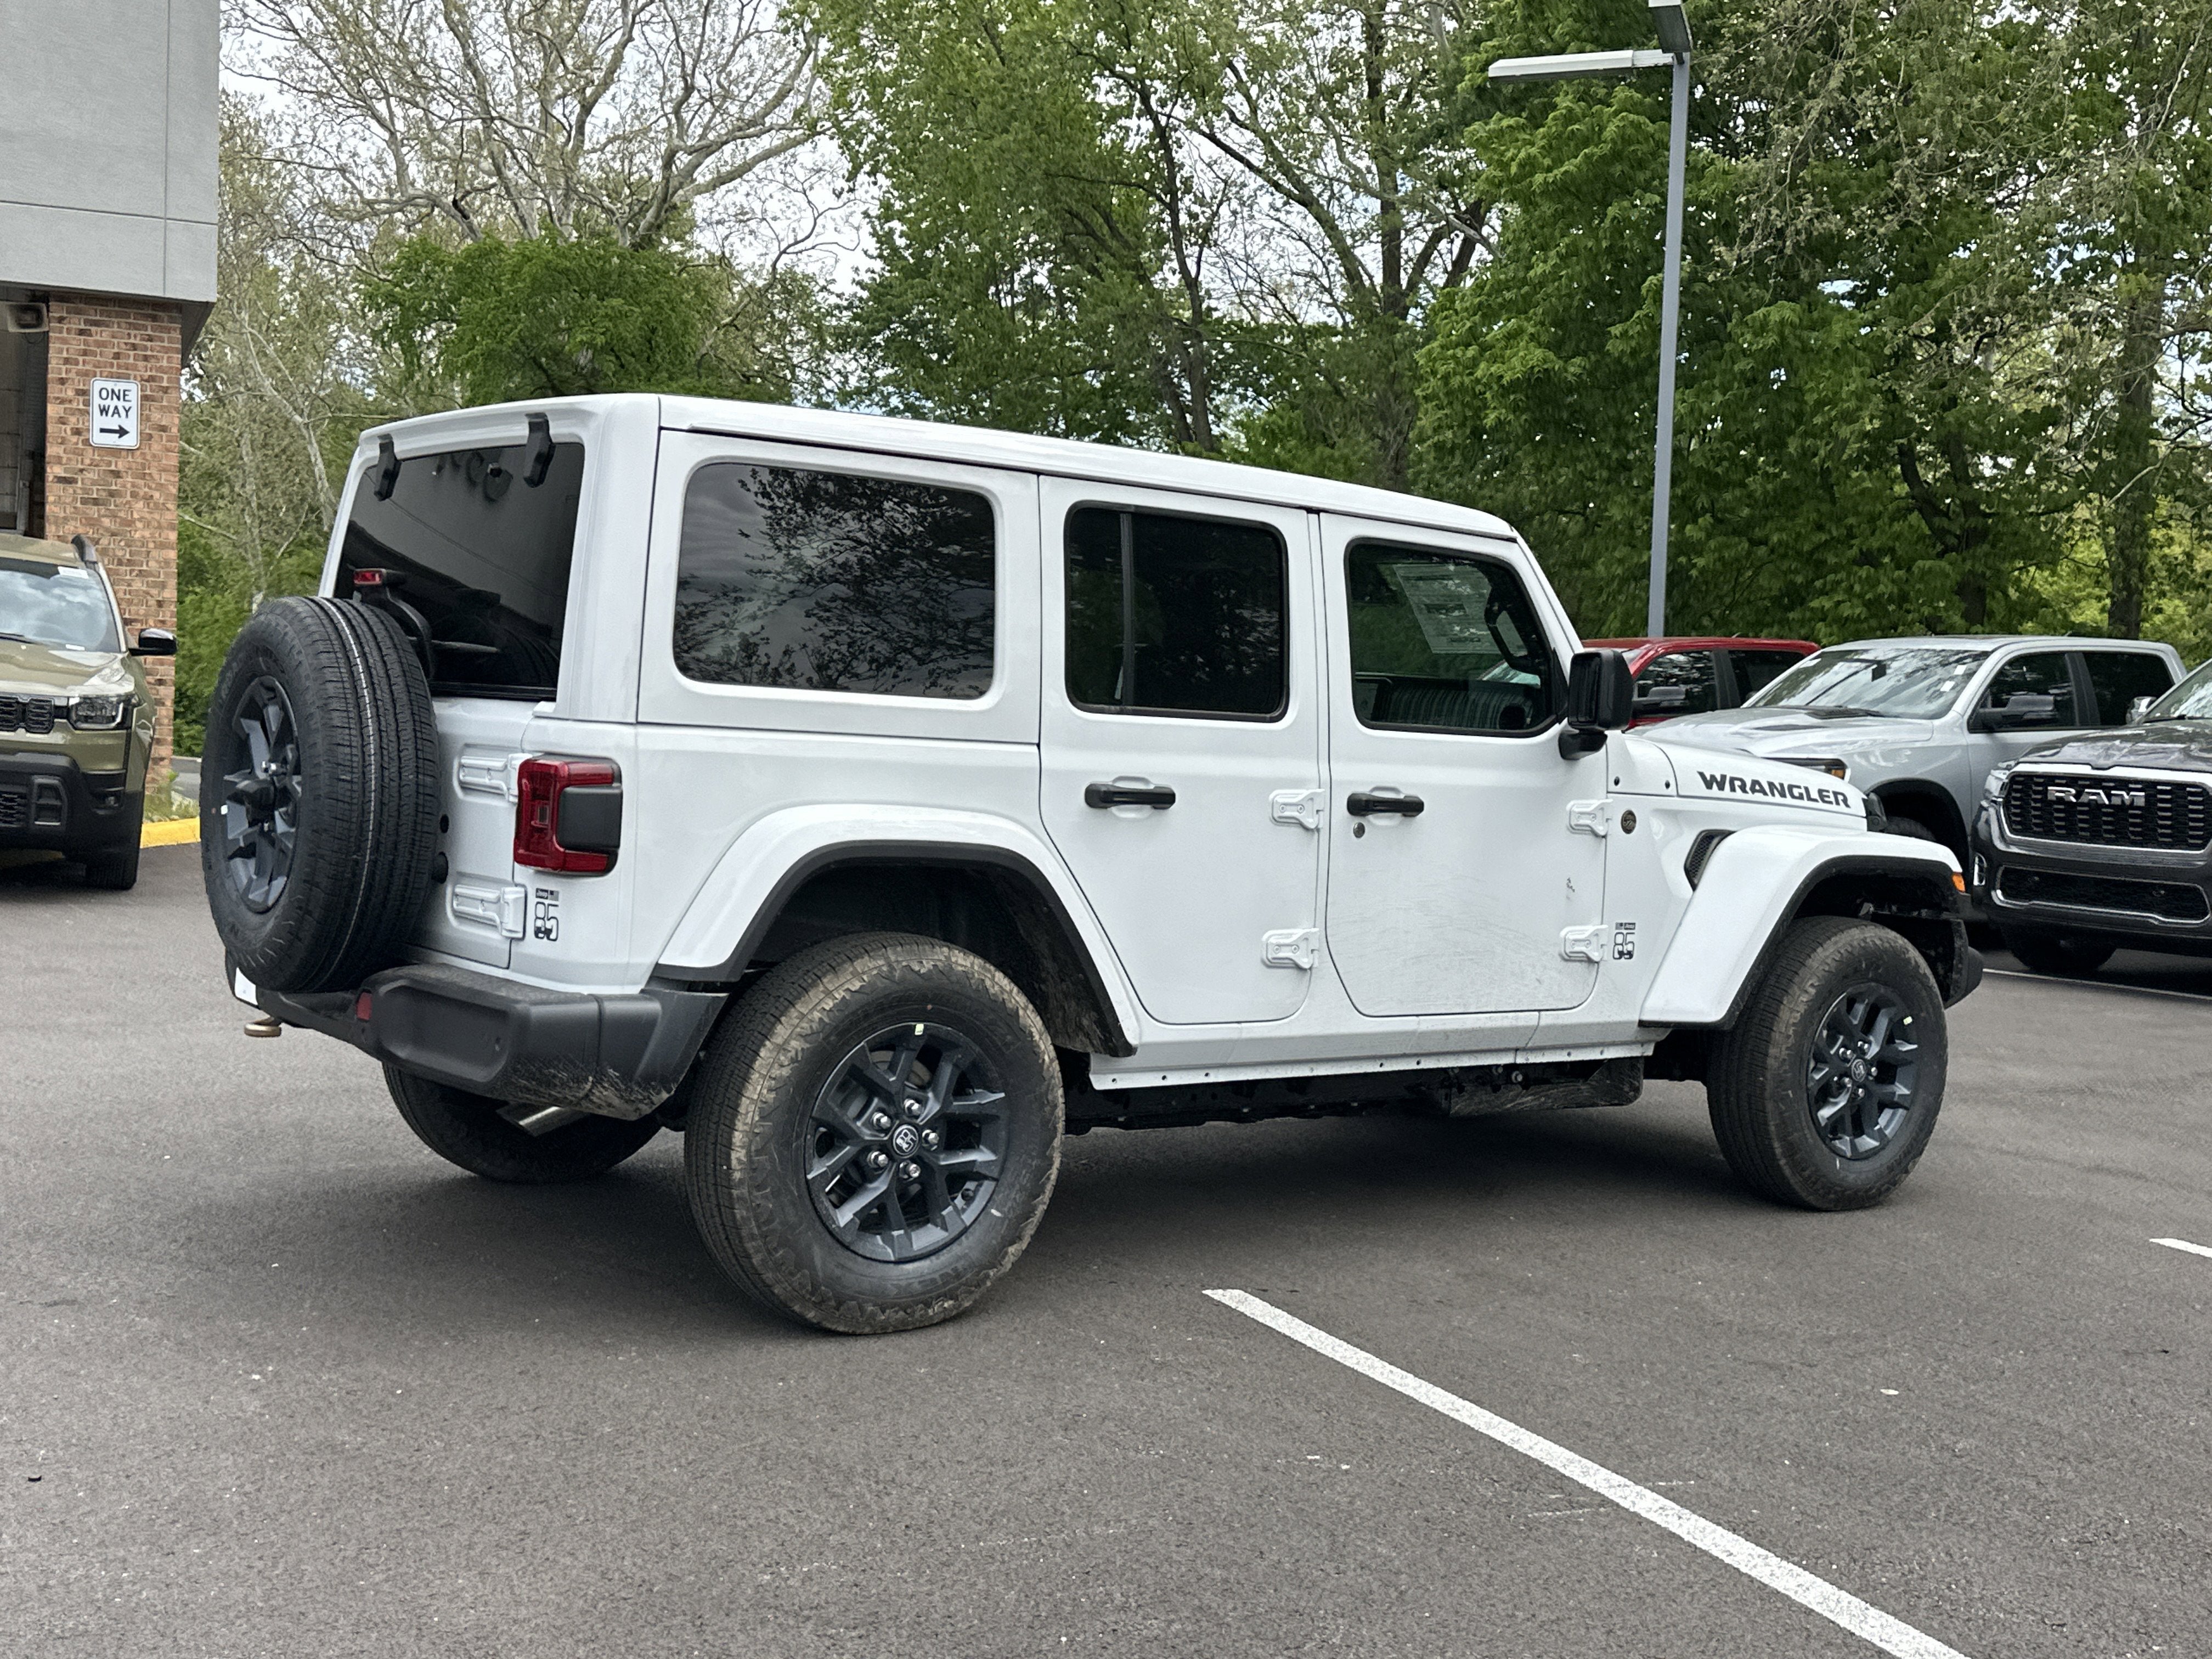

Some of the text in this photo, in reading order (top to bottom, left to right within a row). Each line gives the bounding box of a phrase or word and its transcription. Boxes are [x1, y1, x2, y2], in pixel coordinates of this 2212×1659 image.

[99, 387, 132, 402] ONE
[98, 404, 132, 418] WAY
[1697, 770, 1851, 808] WRANGLER
[2047, 786, 2145, 806] RAM
